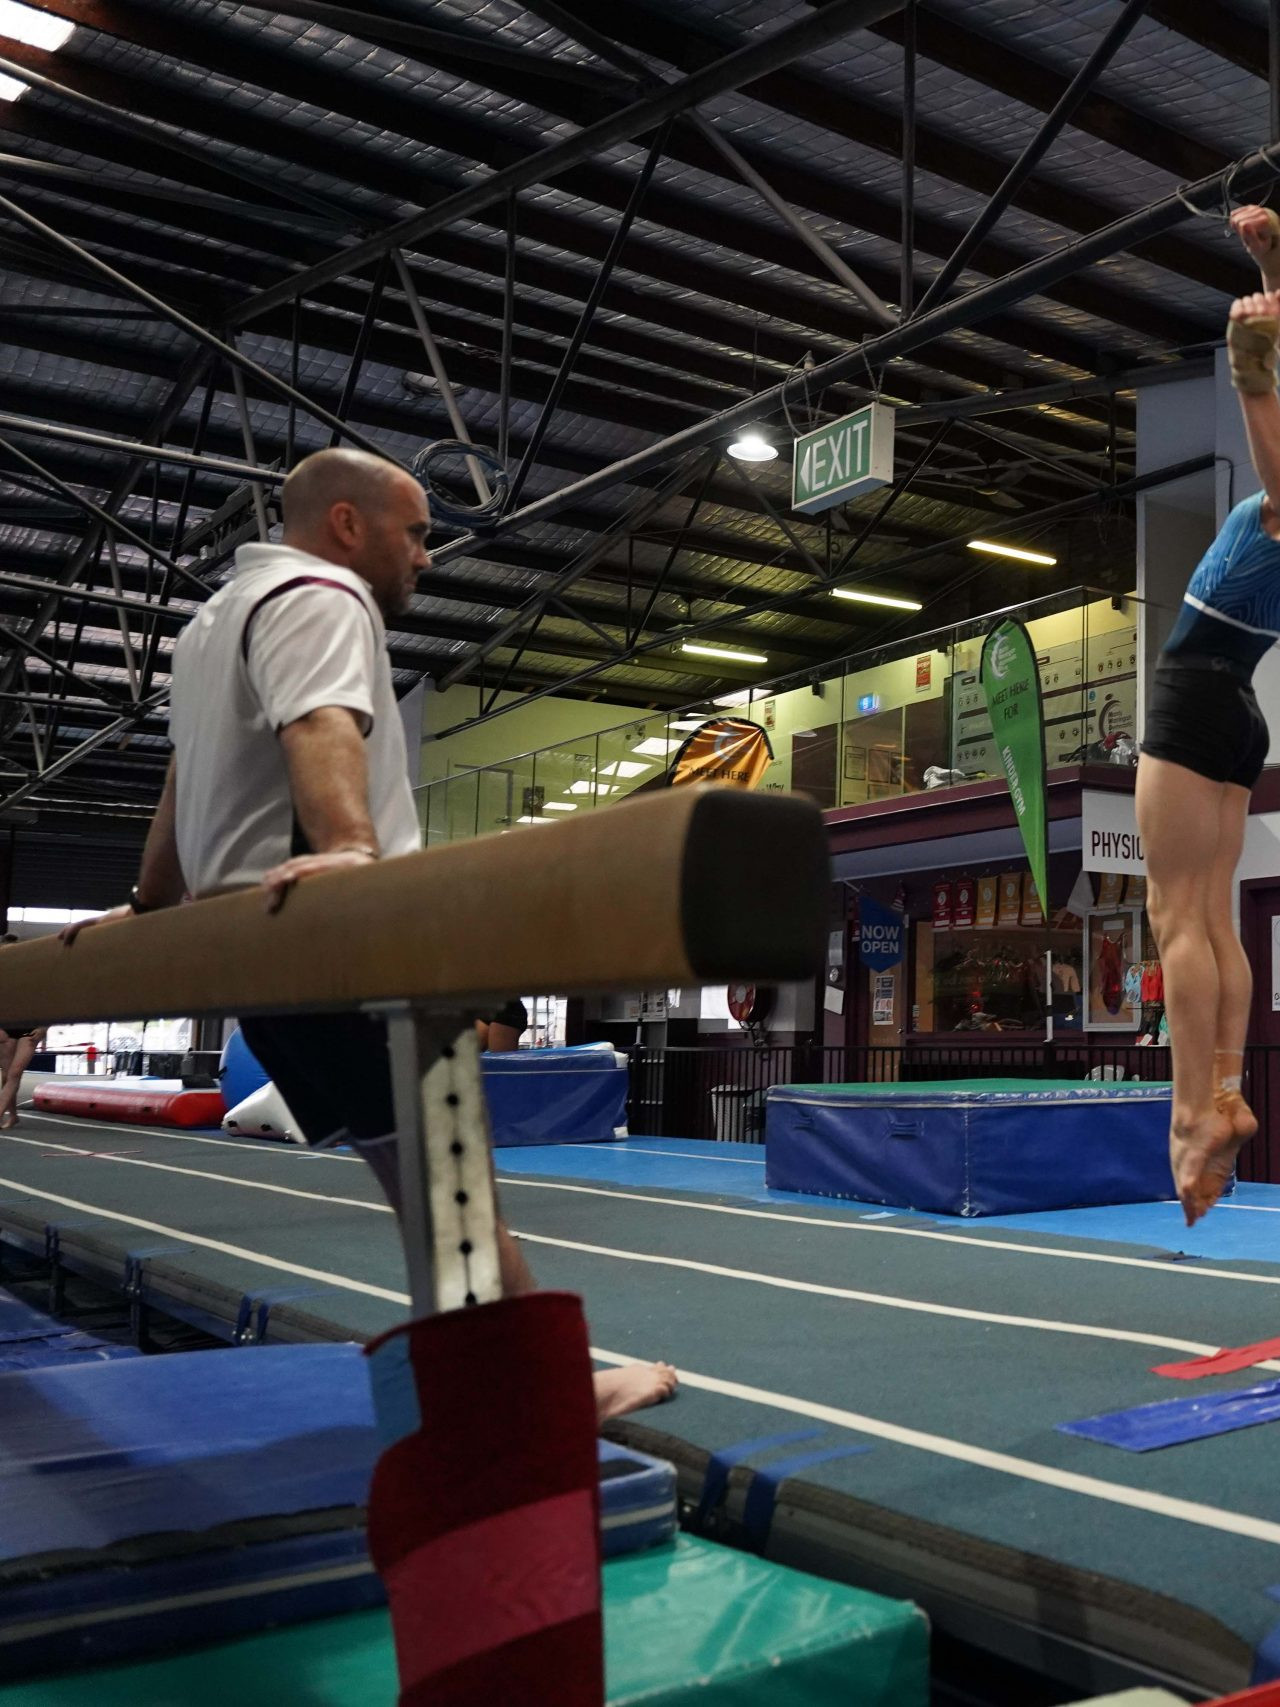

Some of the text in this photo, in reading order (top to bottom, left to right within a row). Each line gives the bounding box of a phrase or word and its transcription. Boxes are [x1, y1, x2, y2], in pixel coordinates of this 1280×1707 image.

[812, 419, 868, 492] EXIT
[1004, 703, 1019, 720] FOR
[721, 770, 750, 781] HERE
[861, 925, 900, 940] NOW
[861, 941, 899, 954] OPEN
